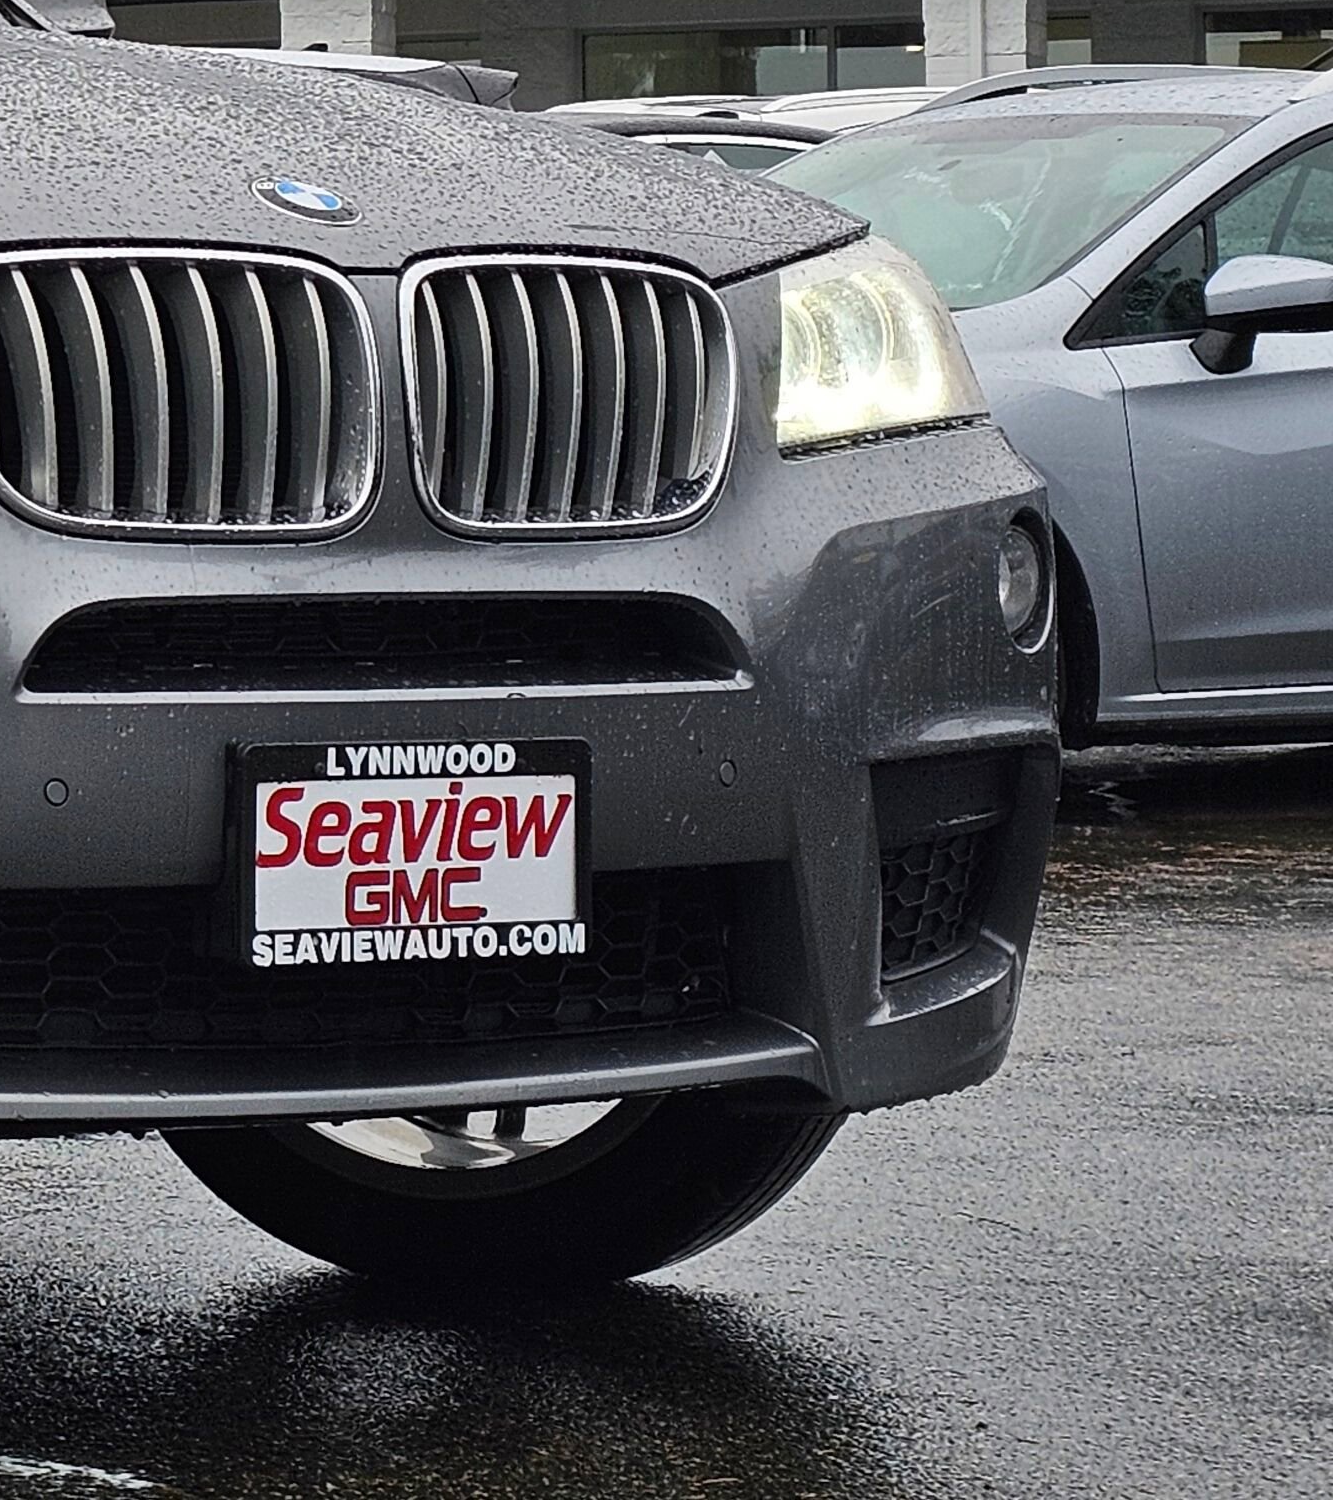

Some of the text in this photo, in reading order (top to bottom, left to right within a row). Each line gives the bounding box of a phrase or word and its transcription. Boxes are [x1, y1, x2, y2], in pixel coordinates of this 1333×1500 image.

[326, 743, 517, 777] LYNNWOOD
[255, 781, 574, 869] Seaview
[344, 866, 488, 927] GMC
[251, 922, 587, 968] SEAVIEWAUTO.COM
